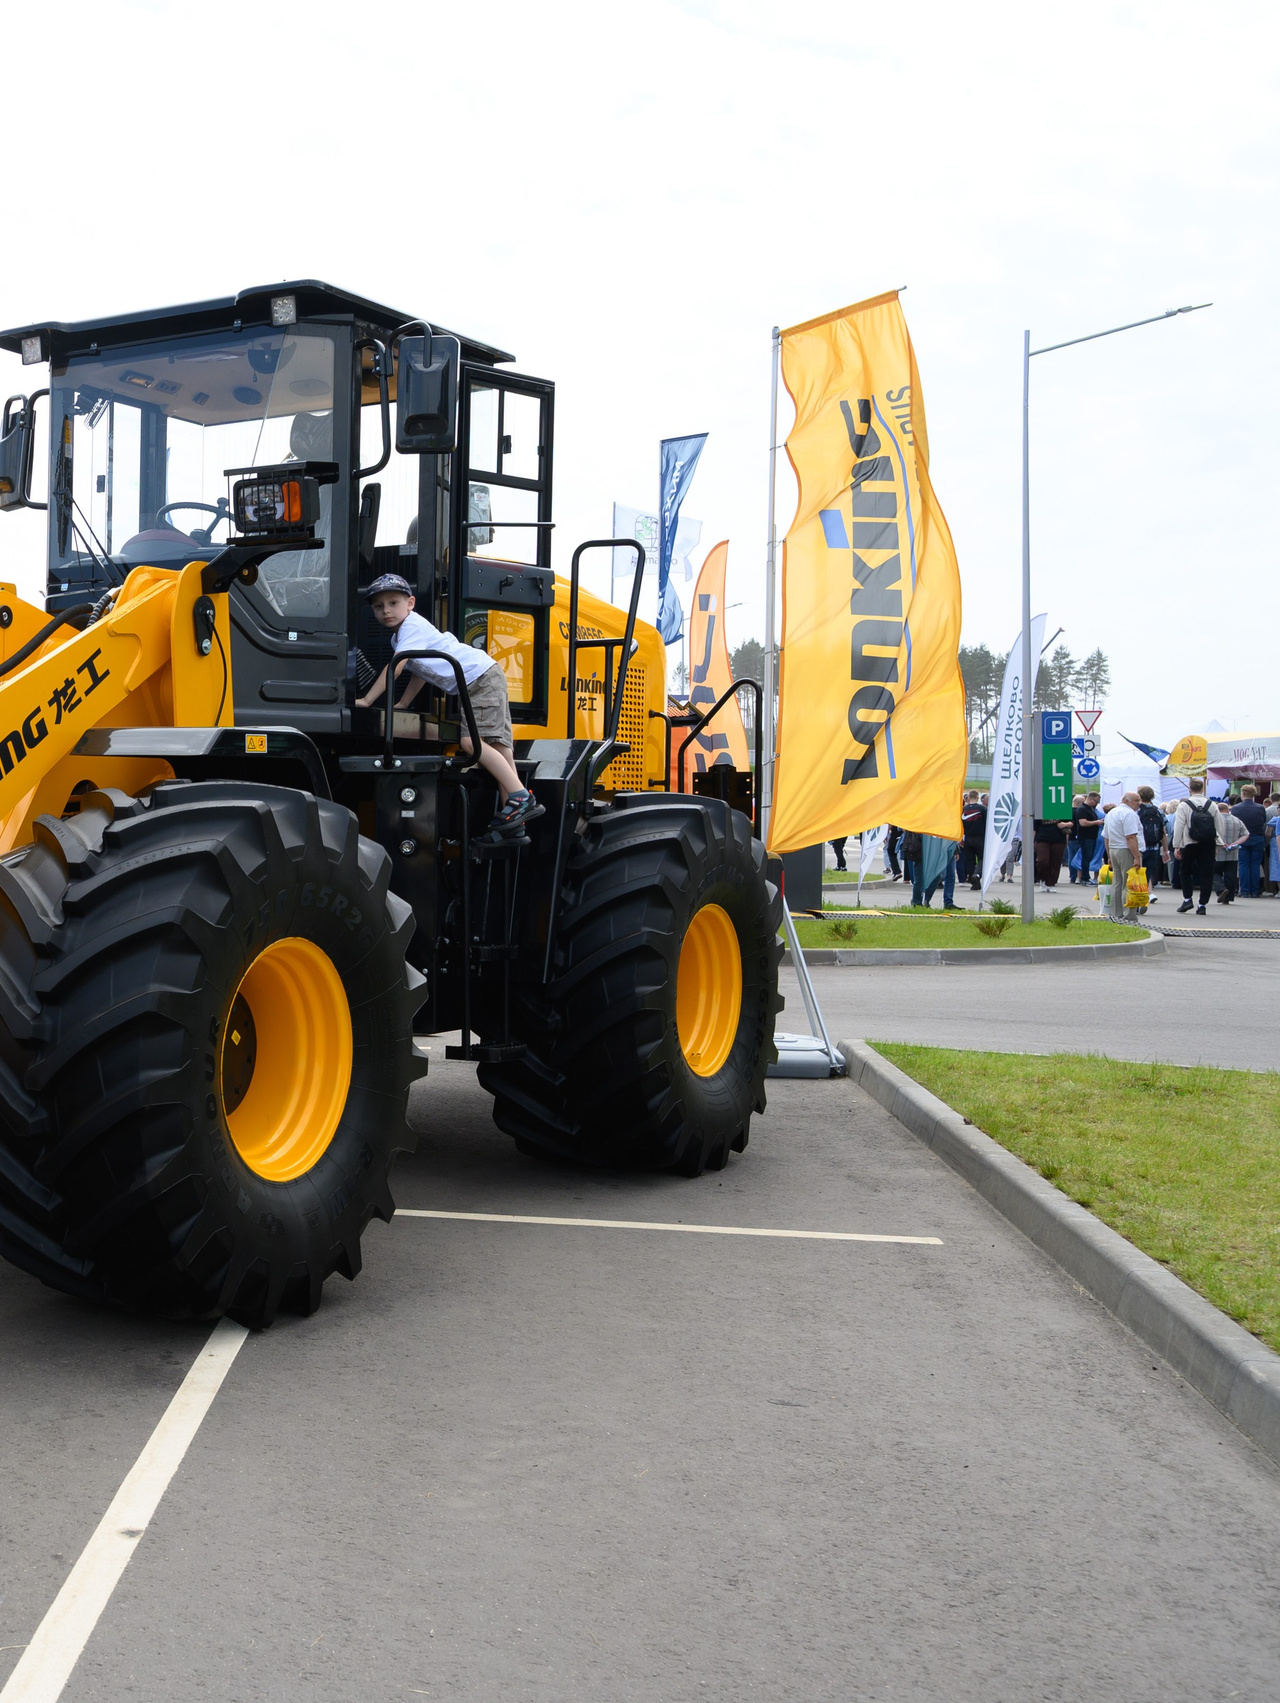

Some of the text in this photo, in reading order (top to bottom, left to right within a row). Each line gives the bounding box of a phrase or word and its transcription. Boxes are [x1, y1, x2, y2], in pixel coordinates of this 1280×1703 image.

[819, 398, 905, 785] LONKING
[47, 647, 111, 725] 龙工
[577, 696, 597, 712] 龙工
[1001, 676, 1020, 780] ЩЕЛКОВО
[1051, 720, 1064, 736] P
[1051, 759, 1064, 777] L
[1049, 786, 1065, 804] 11
